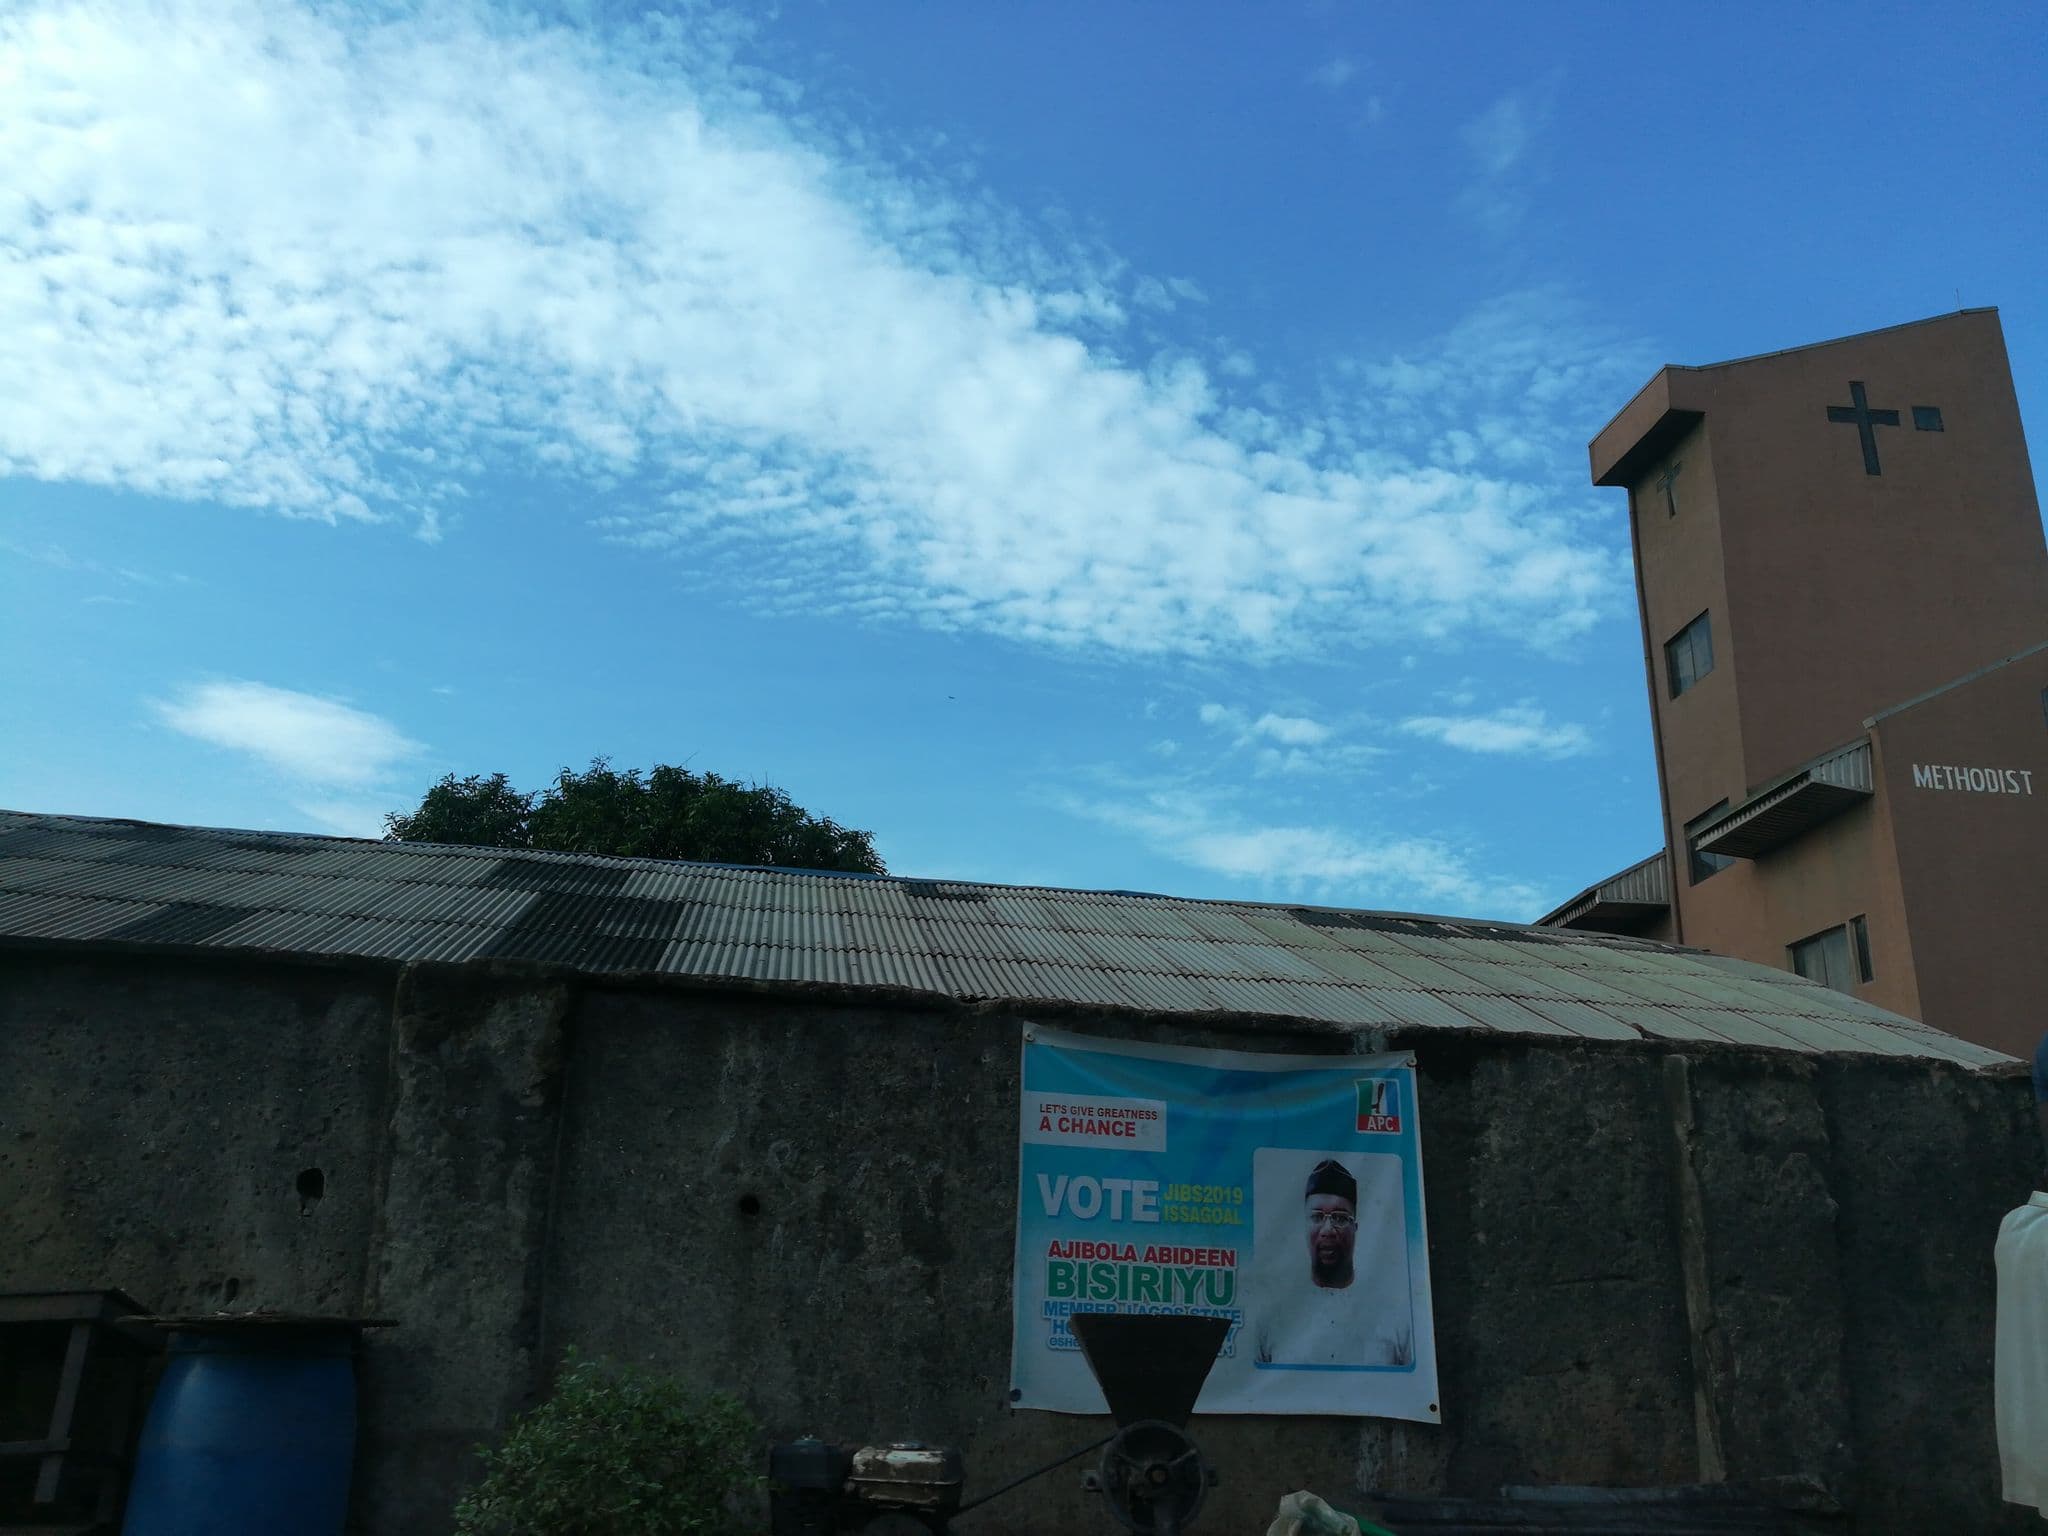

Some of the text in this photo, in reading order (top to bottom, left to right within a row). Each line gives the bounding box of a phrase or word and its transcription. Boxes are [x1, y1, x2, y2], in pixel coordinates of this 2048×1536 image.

[1912, 764, 2033, 795] METHODIST
[1039, 1104, 1158, 1120] LET'S GIVE GREATNESS
[1367, 1116, 1394, 1131] APC
[1039, 1117, 1136, 1137] A CHANCE
[1037, 1174, 1160, 1223] VOTE
[1164, 1183, 1243, 1206] JIBS2019
[1048, 1240, 1236, 1267] AJIBOLA ABIDEEN
[1048, 1261, 1235, 1306] BISIRIYU
